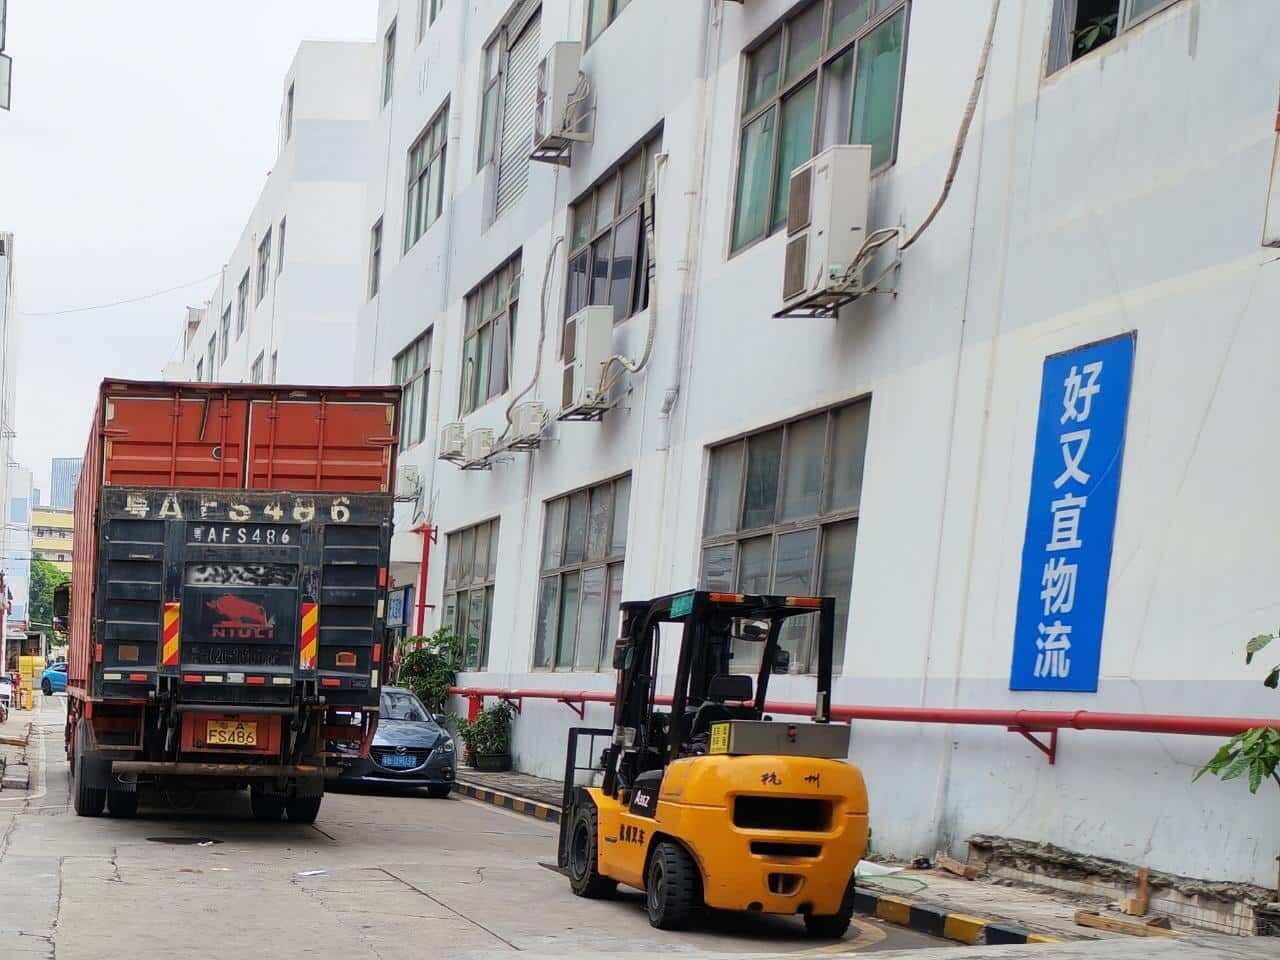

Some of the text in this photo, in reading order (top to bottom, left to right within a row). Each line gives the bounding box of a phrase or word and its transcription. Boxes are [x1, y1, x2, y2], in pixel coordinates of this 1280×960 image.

[1033, 361, 1103, 679] 好又宜物流
[208, 729, 255, 743] FS486
